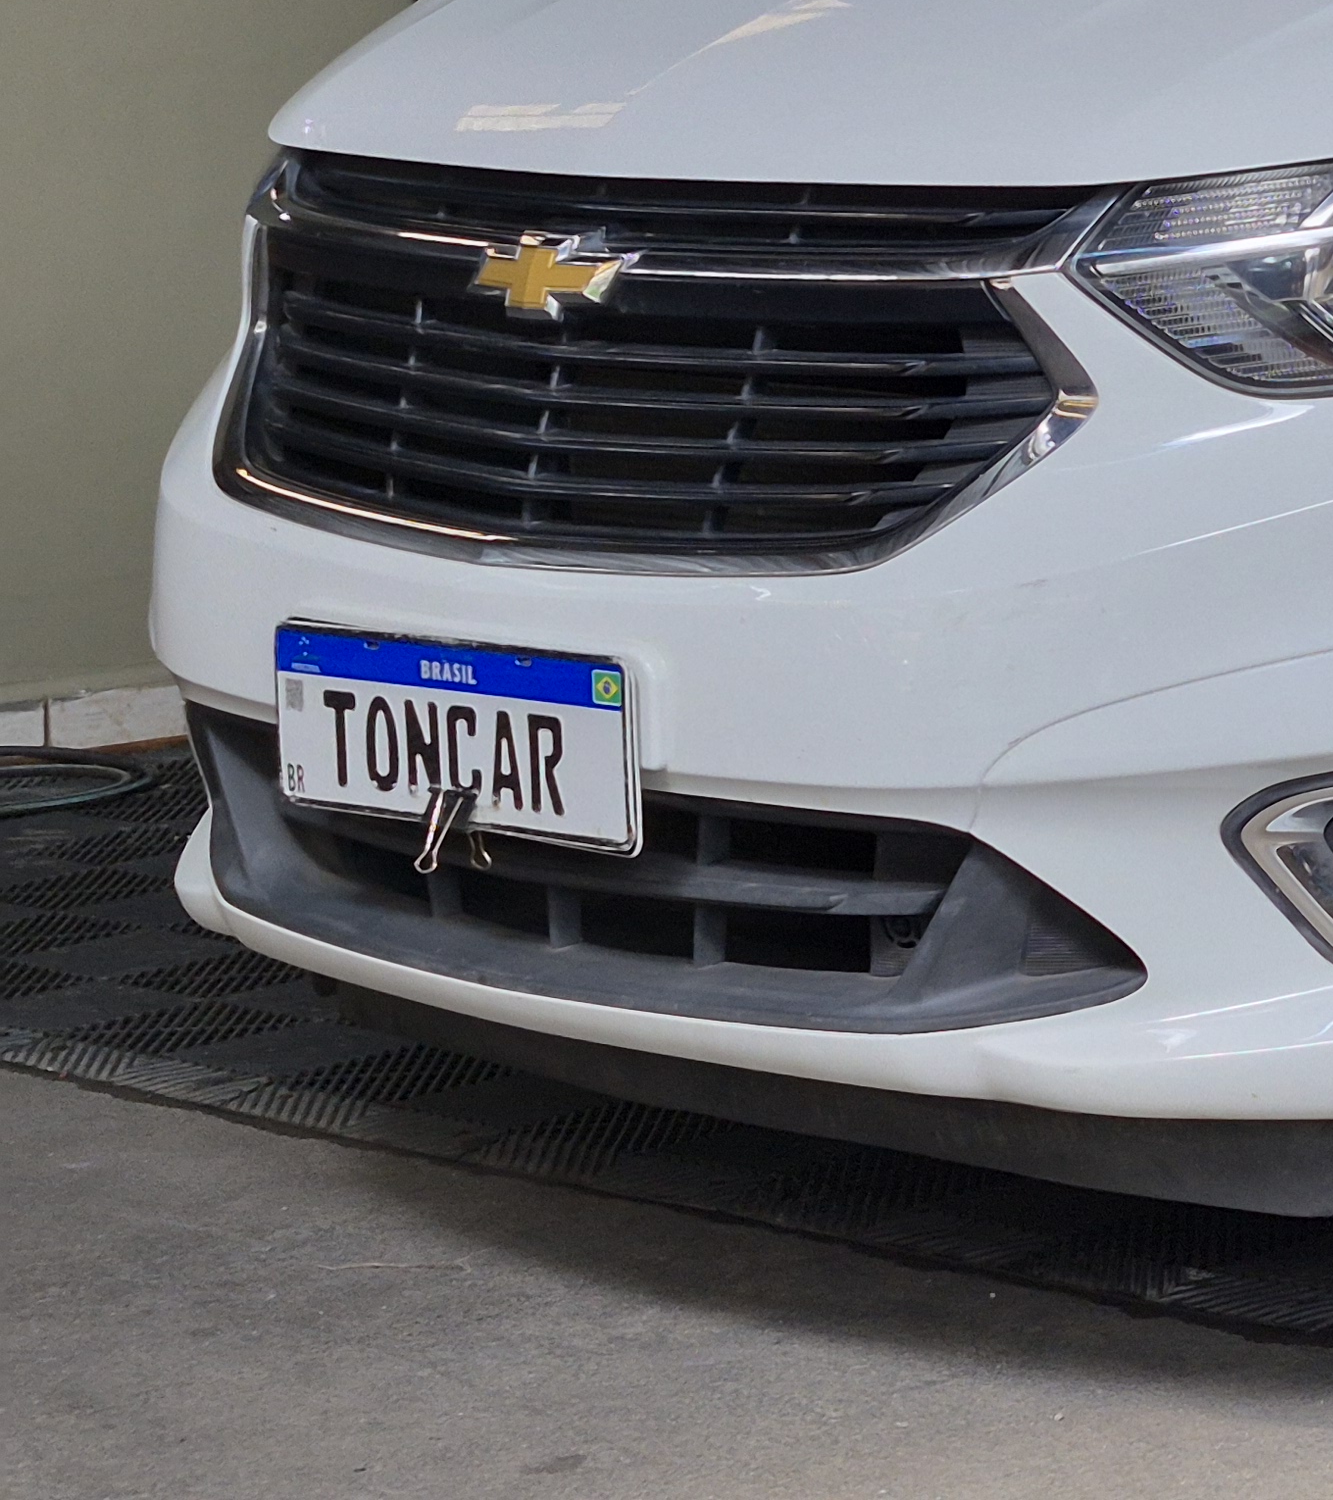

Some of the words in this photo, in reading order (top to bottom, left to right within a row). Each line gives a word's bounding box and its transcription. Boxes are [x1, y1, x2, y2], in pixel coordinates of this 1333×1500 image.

[420, 659, 478, 685] BRASIL
[323, 689, 564, 816] TONCAR
[287, 763, 305, 793] BR
